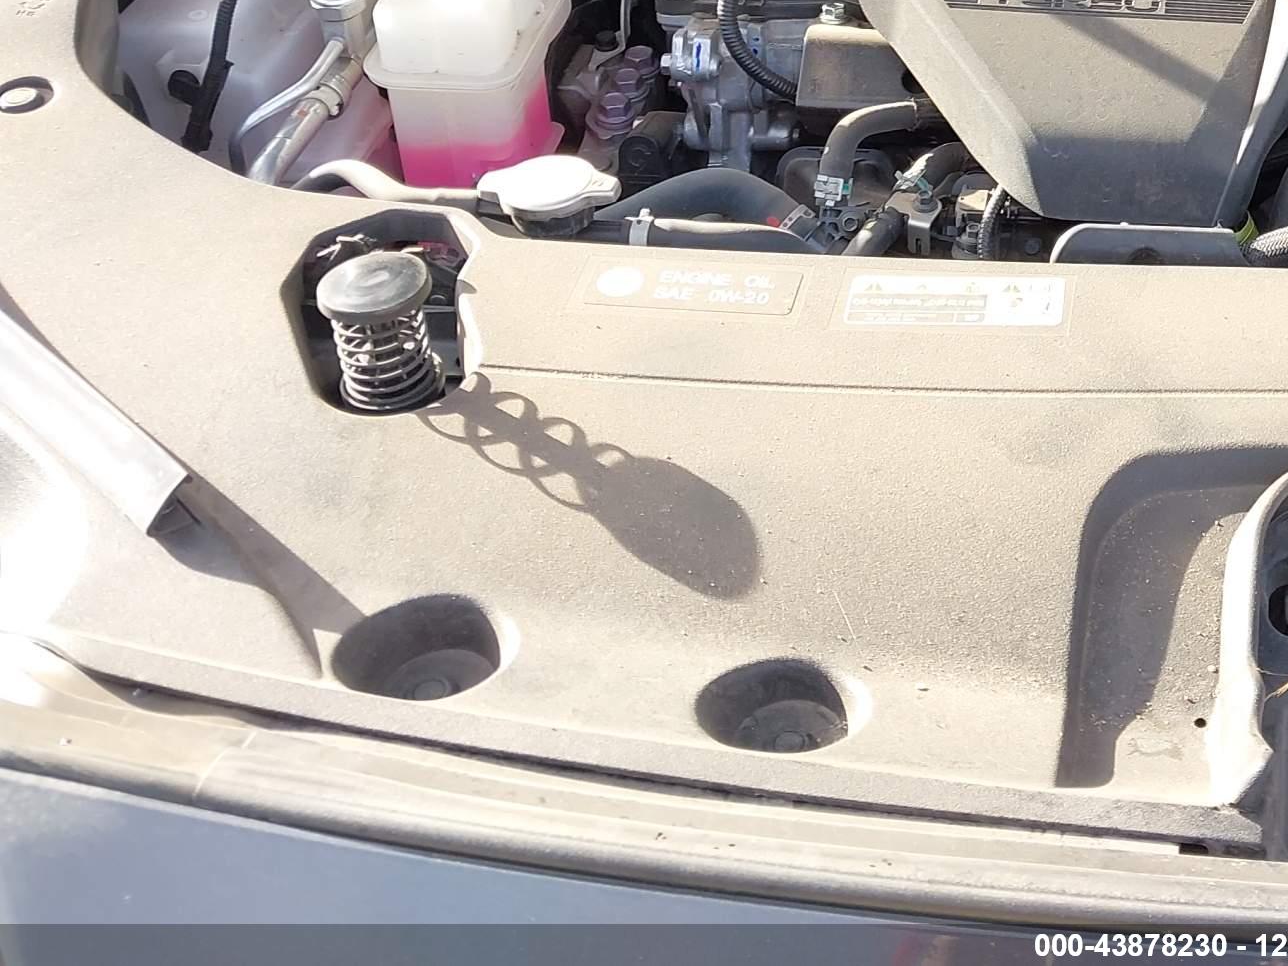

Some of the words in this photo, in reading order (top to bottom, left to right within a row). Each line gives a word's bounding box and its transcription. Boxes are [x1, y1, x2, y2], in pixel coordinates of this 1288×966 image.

[659, 270, 733, 286] ENGINE
[744, 274, 776, 290] OIL
[653, 287, 694, 301] SAE
[708, 289, 770, 305] 0W-20
